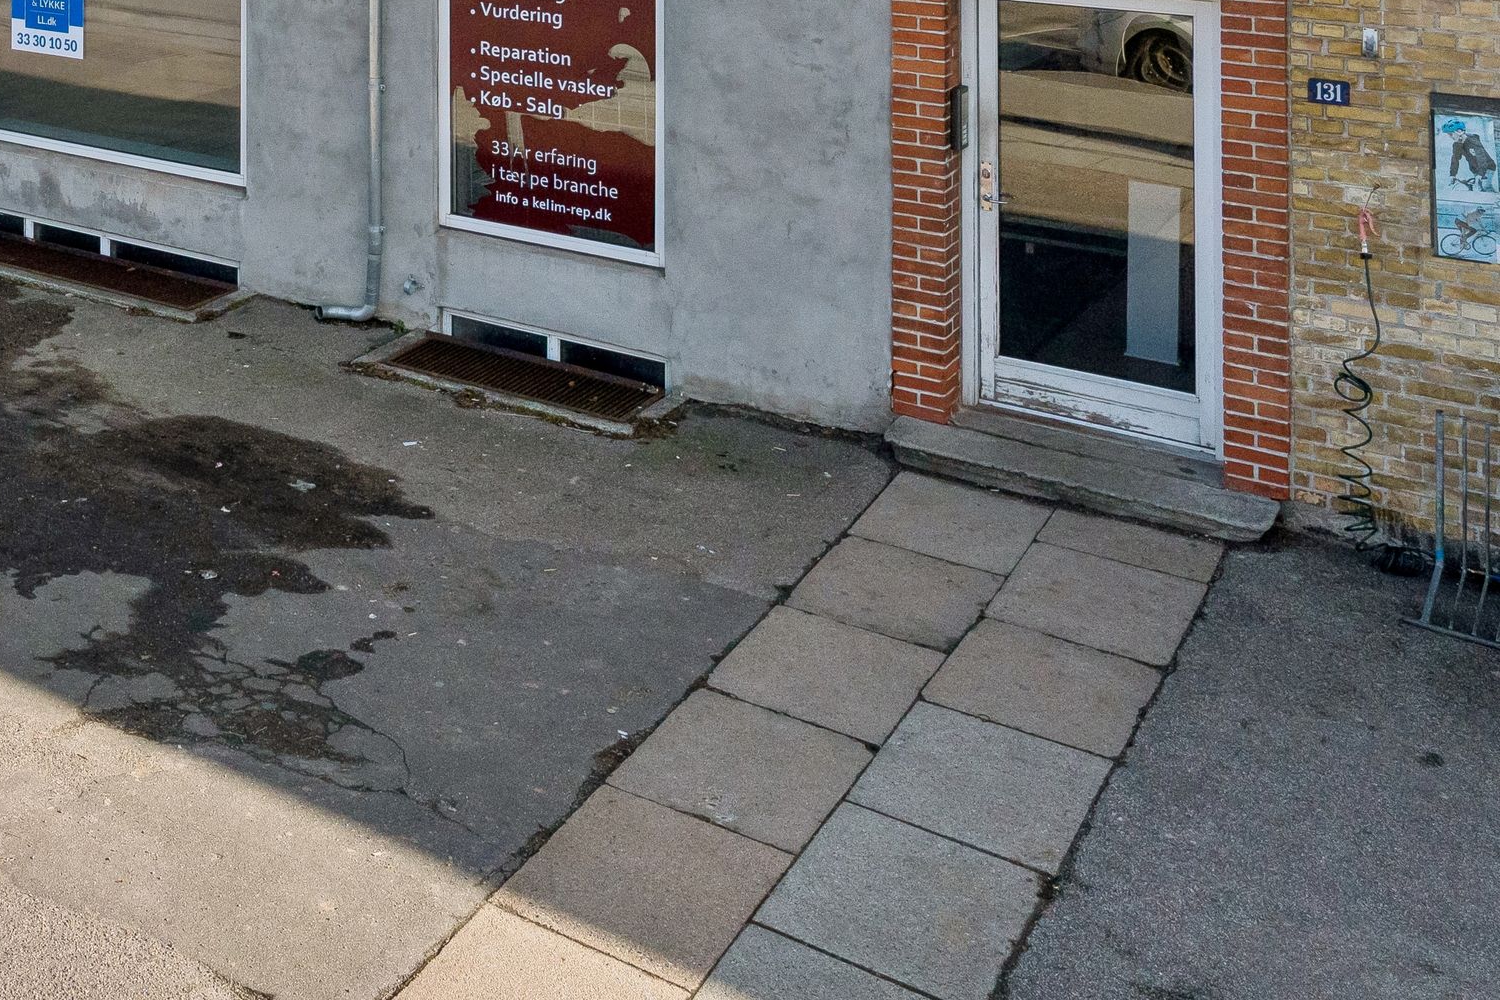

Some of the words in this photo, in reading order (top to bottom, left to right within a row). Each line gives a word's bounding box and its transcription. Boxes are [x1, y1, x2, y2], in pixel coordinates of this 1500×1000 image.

[31, 0, 37, 7] &
[39, 0, 65, 11] LYKKE
[480, 1, 563, 29] Vurdering
[37, 15, 57, 27] LL.dk
[17, 32, 30, 46] 33
[32, 34, 46, 48] 30
[49, 36, 62, 50] 10
[64, 38, 78, 52] 50
[480, 40, 571, 66] Reparation
[480, 65, 553, 89] Specielle
[480, 90, 512, 109] Køb
[526, 96, 563, 120] Salg
[1315, 81, 1342, 103] 131
[491, 140, 509, 156] 33
[534, 148, 597, 175] erfaring
[491, 163, 495, 179] i
[553, 173, 618, 199] branche
[495, 190, 518, 205] info
[522, 198, 529, 207] a
[532, 196, 612, 222] kelim-rep.dk
